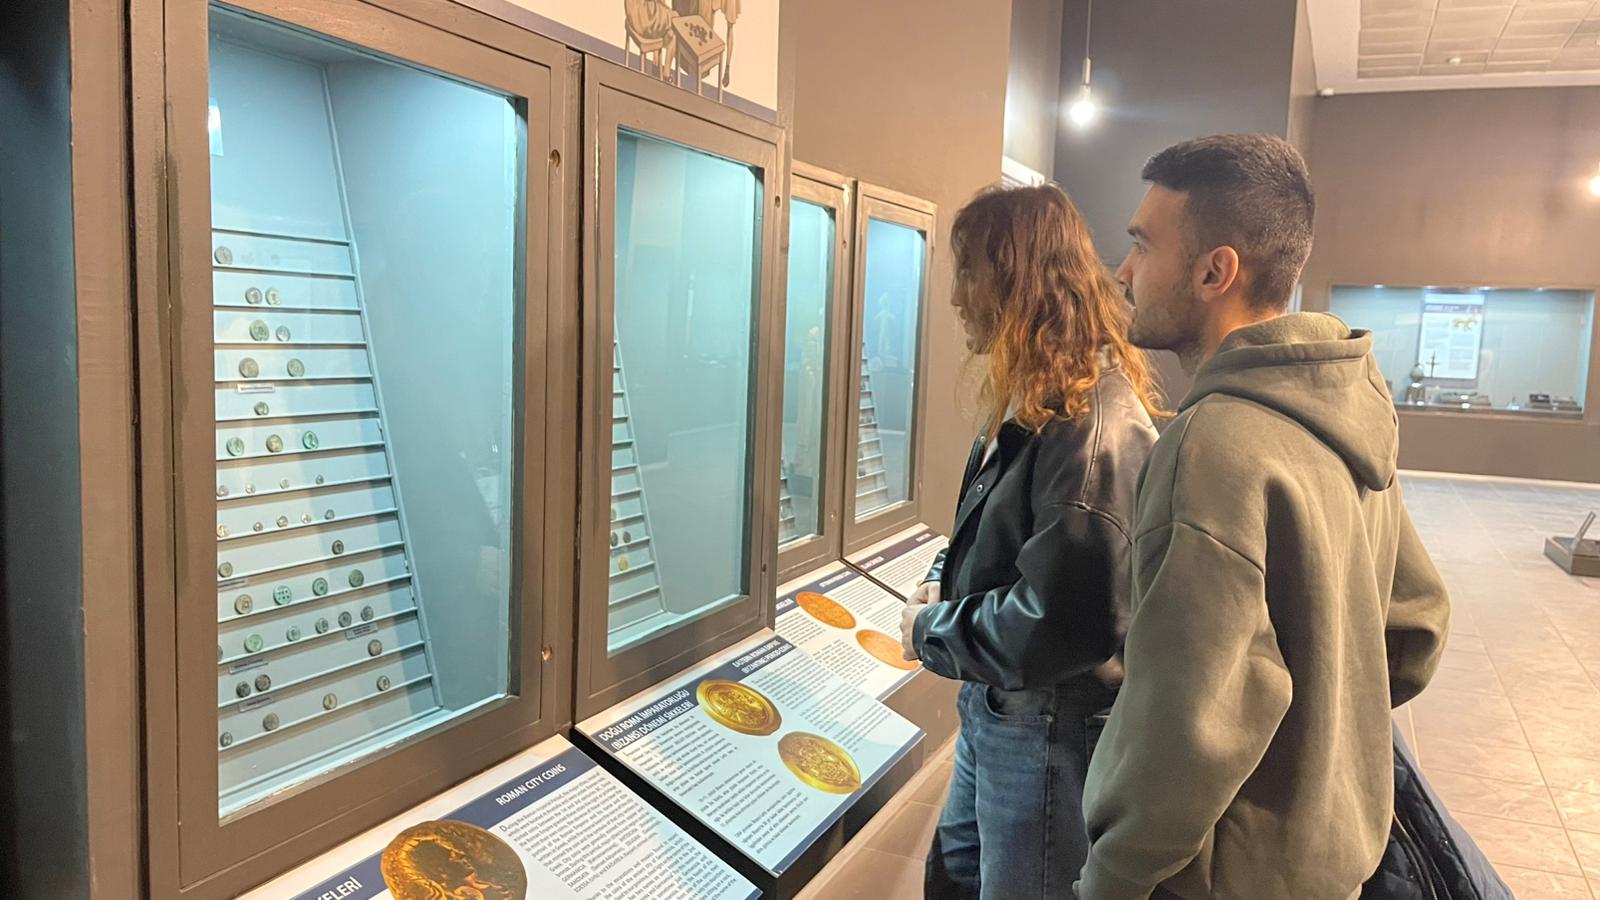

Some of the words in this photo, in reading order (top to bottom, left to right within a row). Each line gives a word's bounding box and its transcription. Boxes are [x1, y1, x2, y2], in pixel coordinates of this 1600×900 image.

[598, 725, 624, 741] DOĞU
[620, 717, 642, 731] ROMA
[637, 689, 690, 719] İMPARATORLUĞU
[610, 730, 644, 750] (BİZANS)
[638, 714, 667, 734] DÖNEMİ
[496, 785, 528, 805] ROMAN
[525, 776, 544, 789] CITY
[542, 764, 566, 780] COINS
